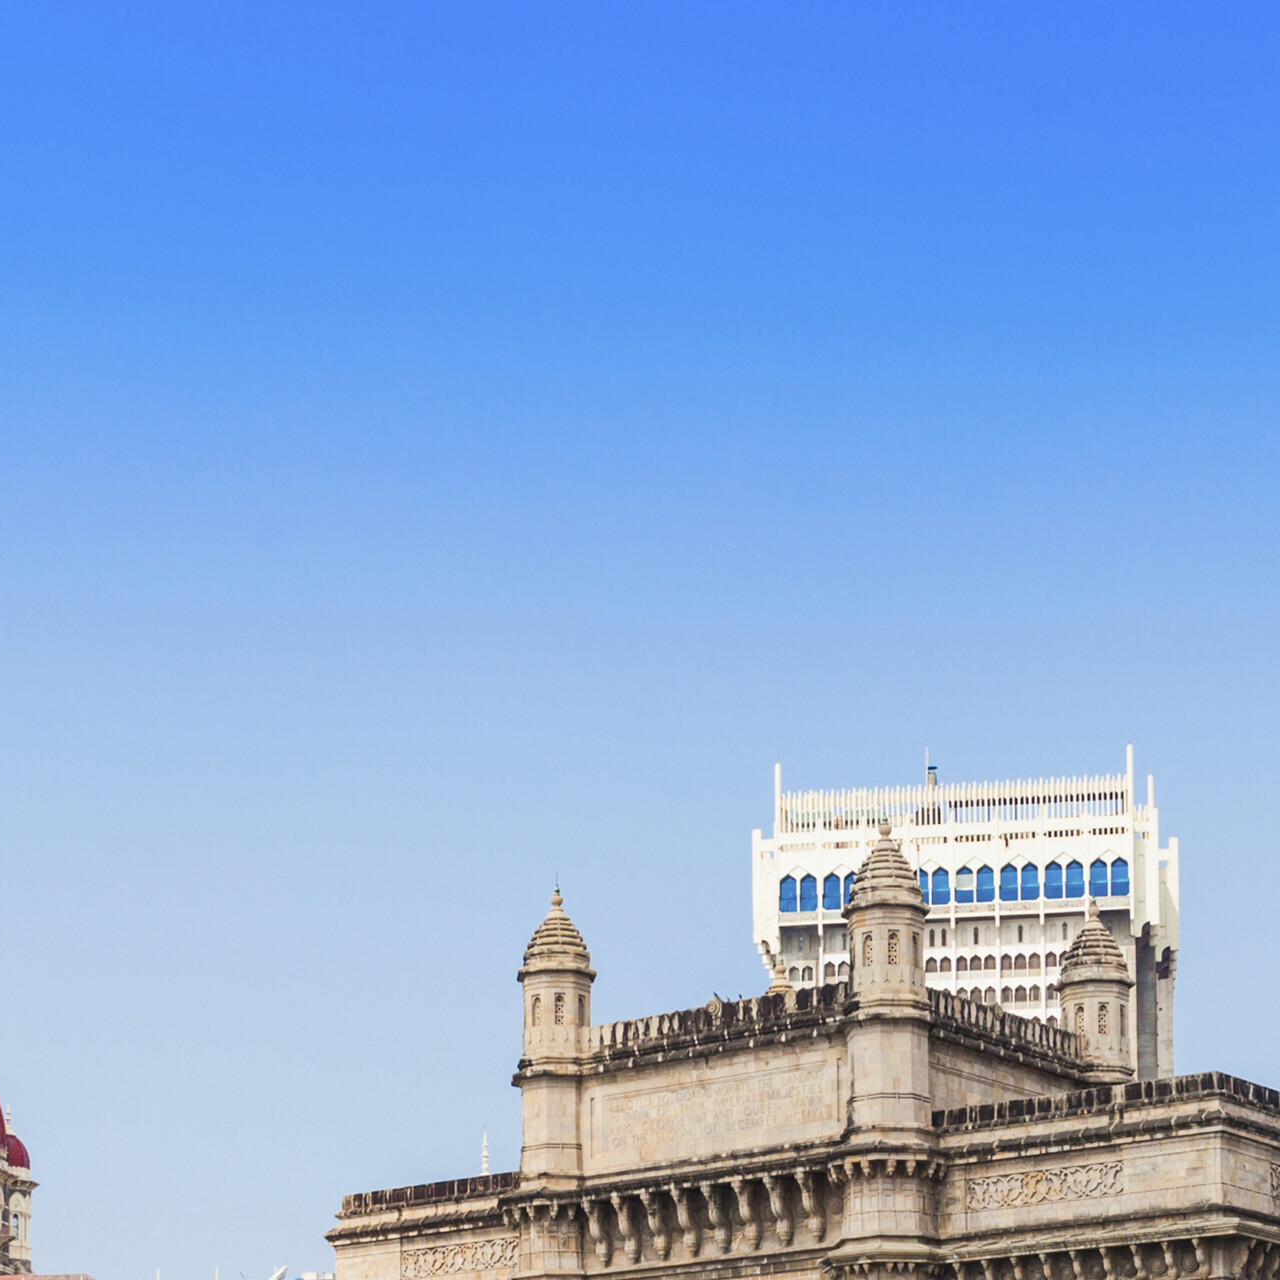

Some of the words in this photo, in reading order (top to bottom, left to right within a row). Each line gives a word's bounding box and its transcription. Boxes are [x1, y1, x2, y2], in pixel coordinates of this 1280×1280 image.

[609, 1097, 652, 1113] ERECTED
[657, 1094, 670, 1106] TO
[757, 1077, 775, 1090] THE
[781, 1069, 824, 1087] LANDING
[624, 1110, 649, 1121] INDIA
[656, 1107, 670, 1117] OF
[680, 1101, 705, 1113] THEIR
[713, 1092, 758, 1107] IMPERIAL
[766, 1082, 823, 1100] MAJESTIES
[612, 1137, 626, 1147] ON
[631, 1132, 649, 1145] THE
[655, 1127, 697, 1143] SECOND
[704, 1122, 720, 1135] OF
[725, 1115, 777, 1132] DECEMBER
[785, 1107, 823, 1123] MCMXI
[642, 1116, 686, 1132] GEORGE
[713, 1109, 733, 1121] AND
[744, 1102, 781, 1117] QUEEN
[791, 1096, 822, 1109] MARY
